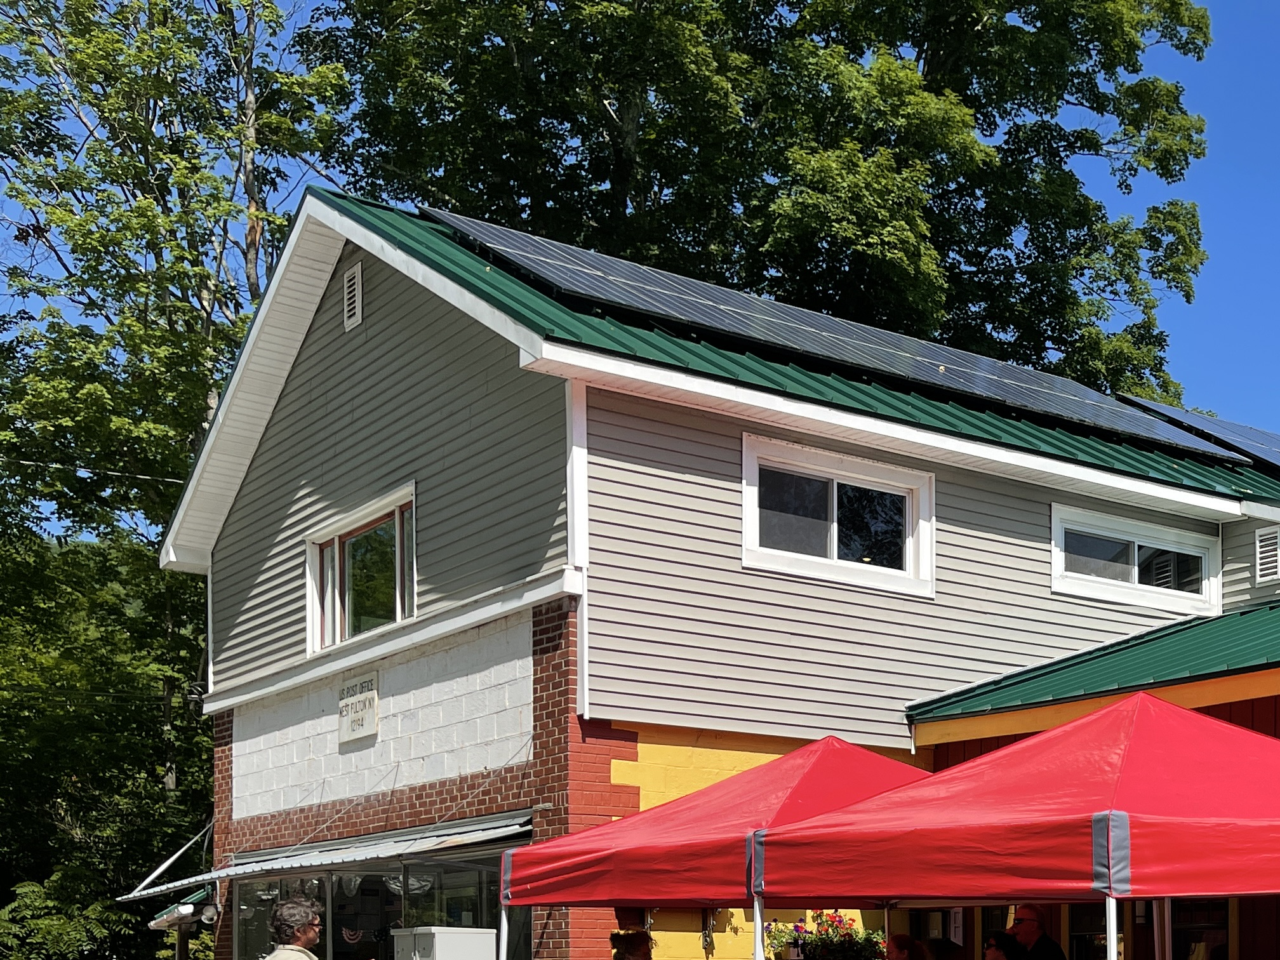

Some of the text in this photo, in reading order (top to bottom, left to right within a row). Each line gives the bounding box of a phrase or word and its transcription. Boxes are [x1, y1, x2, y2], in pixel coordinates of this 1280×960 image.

[346, 684, 358, 698] POST
[359, 678, 374, 695] OFFICE
[351, 698, 367, 716] FULTON
[351, 717, 364, 732] 12194
